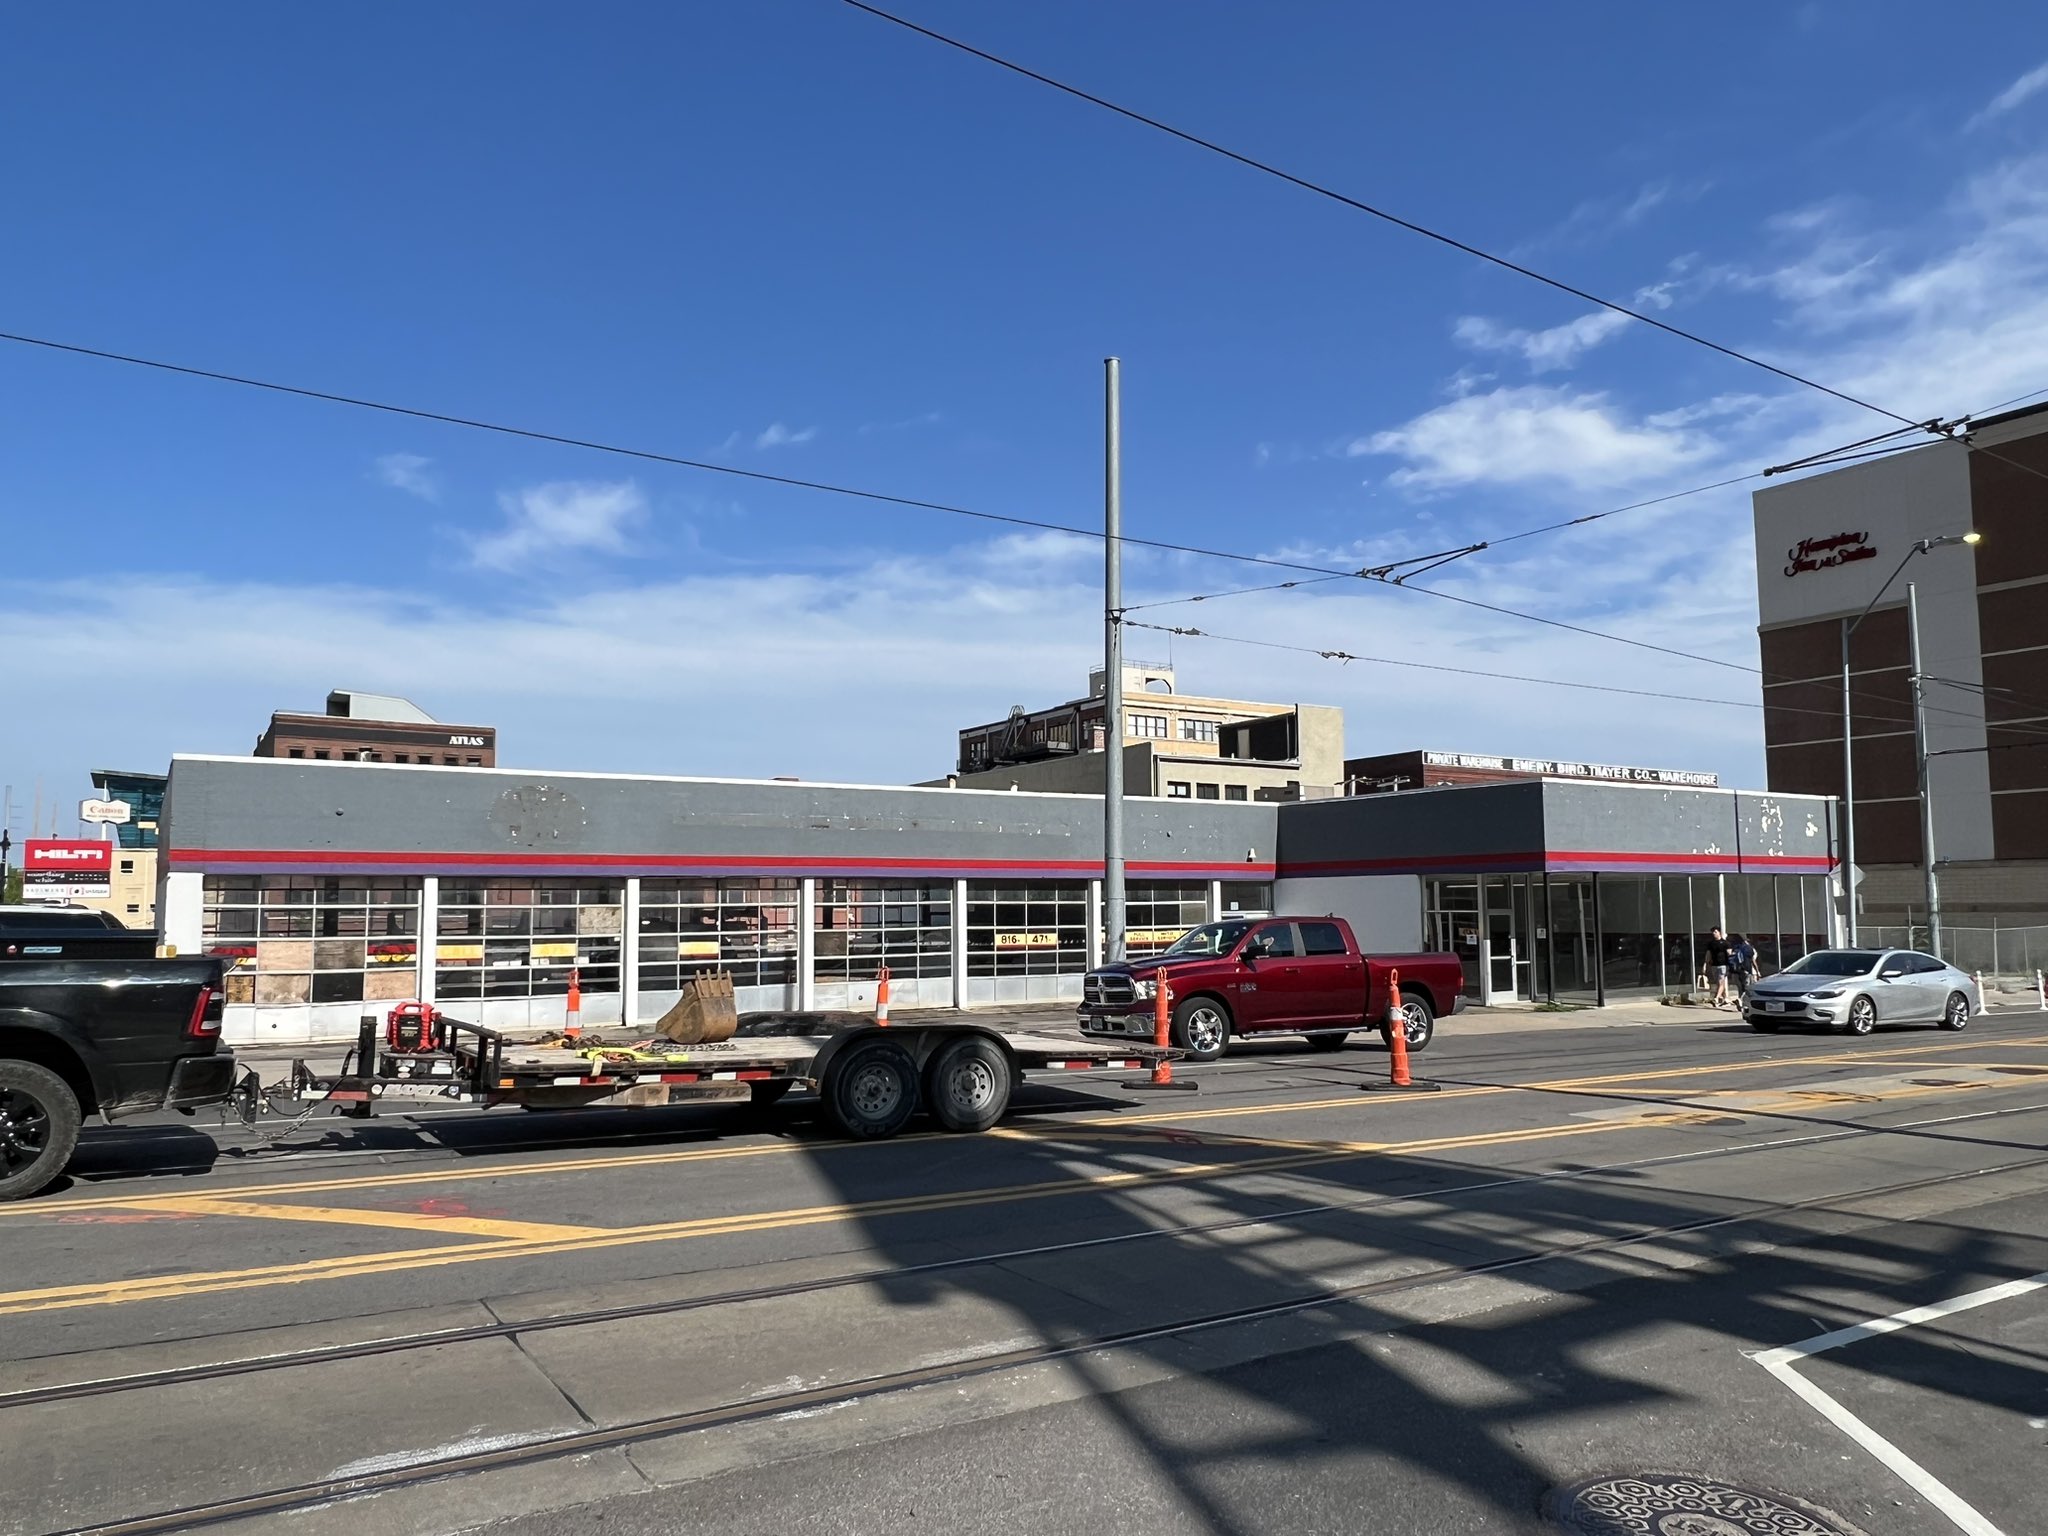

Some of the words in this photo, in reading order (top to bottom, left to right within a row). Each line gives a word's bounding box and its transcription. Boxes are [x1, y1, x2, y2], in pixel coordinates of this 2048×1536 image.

[449, 735, 484, 746] ATLAS
[1588, 766, 1630, 779] THAYER
[1658, 771, 1717, 785] WAREHOUSE
[90, 806, 124, 815] Canon
[34, 849, 103, 859] HILTI
